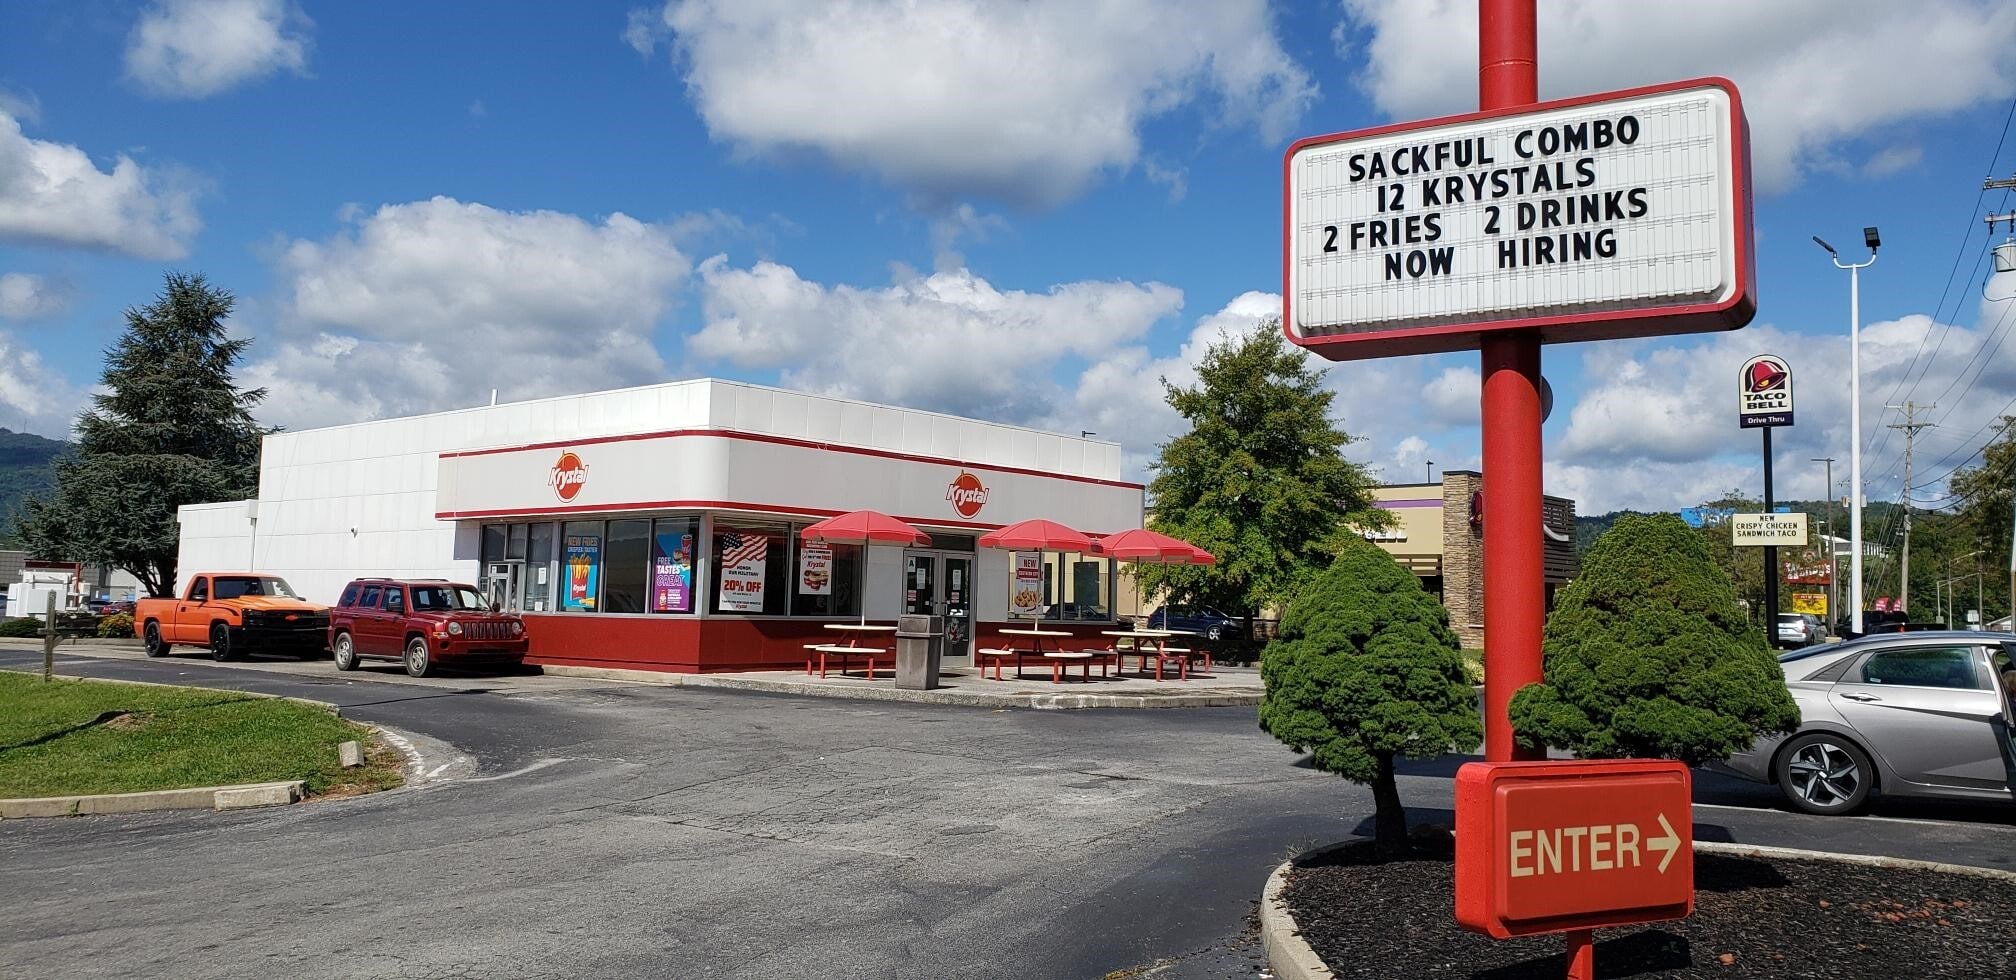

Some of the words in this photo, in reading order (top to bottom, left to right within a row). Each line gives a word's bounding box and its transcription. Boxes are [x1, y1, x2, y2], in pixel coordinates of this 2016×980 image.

[1348, 137, 1494, 182] SACKFUL
[1514, 115, 1640, 160] COMBO
[1377, 183, 1405, 213] 12
[1422, 157, 1595, 207] KRYSTALS
[1323, 225, 1338, 253] 2
[1350, 212, 1442, 250] FRIES
[1484, 205, 1500, 235] 2
[1517, 187, 1648, 231] DRINKS
[1385, 246, 1455, 281] NOW
[1498, 228, 1617, 269] HIRING
[1744, 393, 1787, 401] TACO
[1747, 401, 1788, 410] BELL
[547, 464, 589, 491] Krystal
[946, 483, 989, 506] Krystal
[656, 565, 681, 575] TASTES
[657, 557, 671, 565] FREE
[908, 559, 915, 567] A
[1023, 559, 1037, 568] NEW
[724, 580, 745, 592] 20%
[746, 581, 762, 593] OFF
[1510, 823, 1641, 877] ENTER
